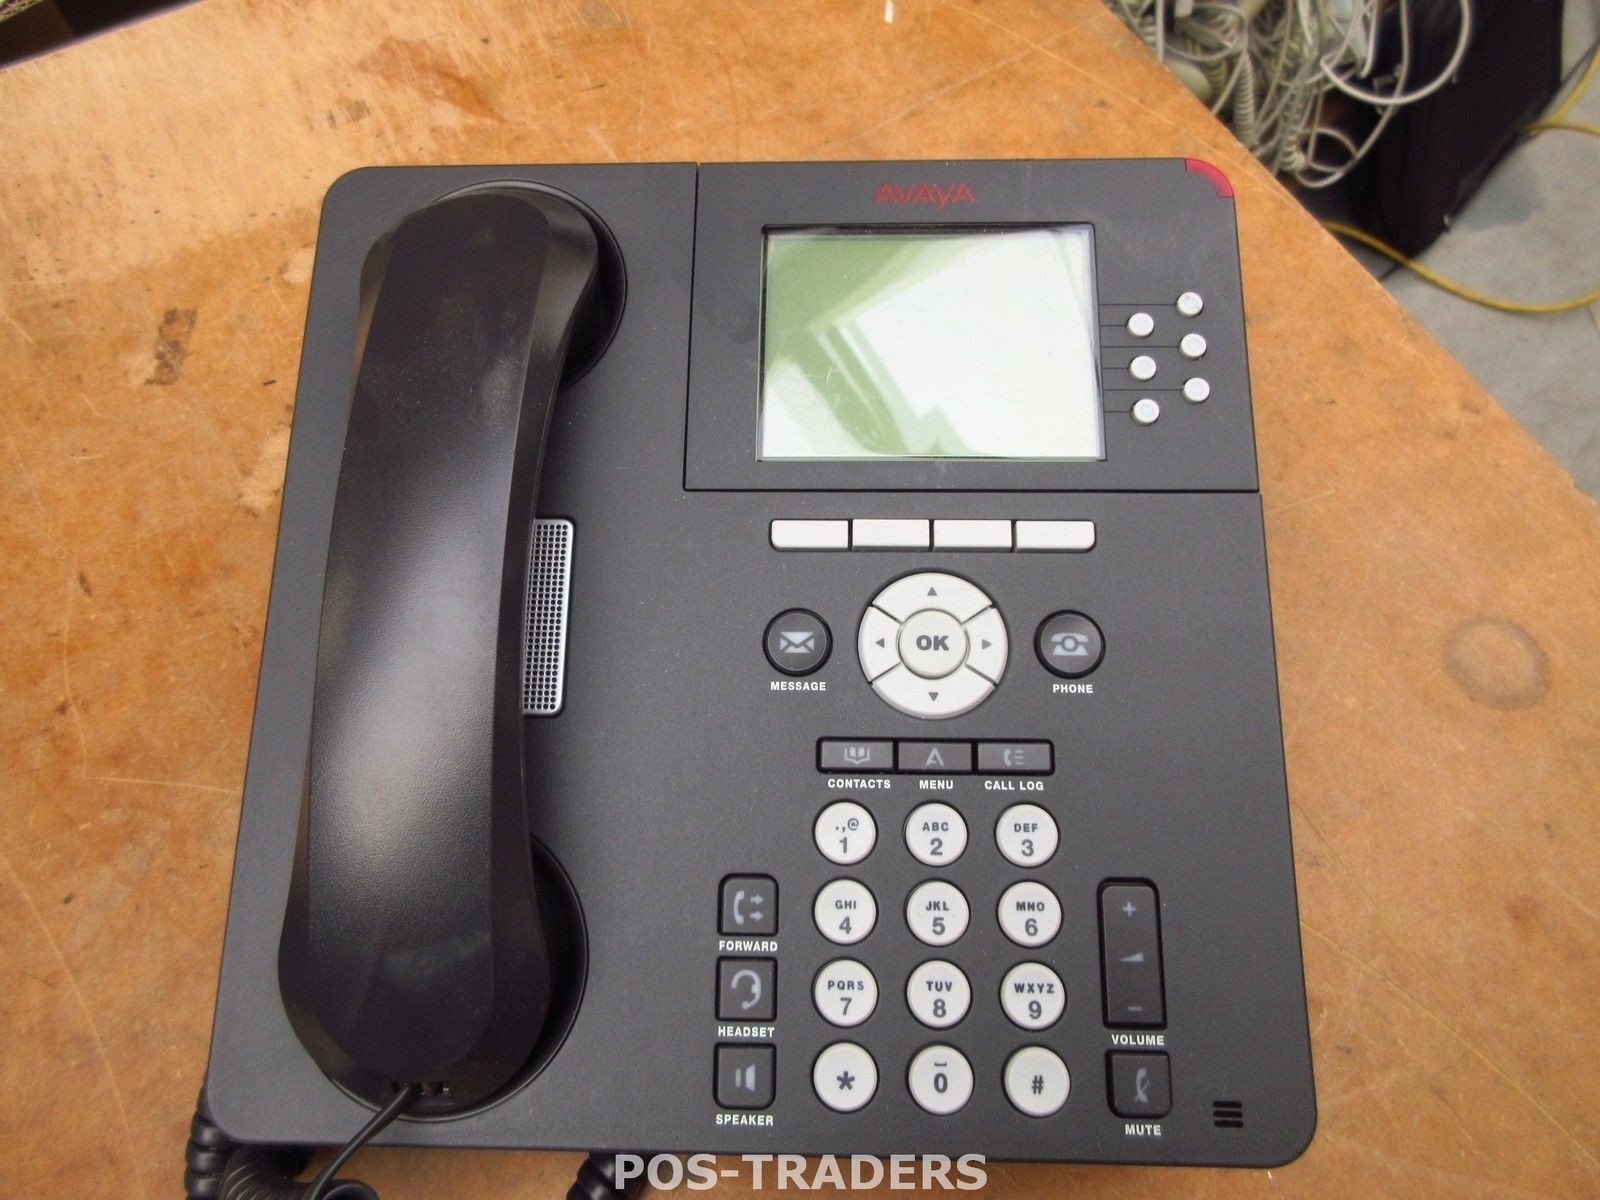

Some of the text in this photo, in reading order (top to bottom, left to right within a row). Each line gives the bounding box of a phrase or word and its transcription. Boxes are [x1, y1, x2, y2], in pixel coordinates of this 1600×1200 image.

[874, 182, 976, 210] AVAYA
[916, 635, 949, 651] OK
[770, 681, 826, 692] MESSAGE
[1052, 684, 1093, 694] PHONE
[827, 778, 891, 789] CONTACTS
[919, 779, 954, 790] MENU
[984, 780, 1044, 791] CALL LOG
[922, 821, 949, 832] ABC
[1013, 823, 1038, 833] DEF
[839, 837, 848, 853] 1
[930, 838, 943, 855] 2
[1021, 839, 1034, 857] 3
[835, 900, 856, 910] GHI
[925, 901, 949, 911] JKL
[1016, 901, 1045, 912] MNO
[839, 917, 851, 934] 4
[932, 917, 945, 935] 5
[1025, 918, 1038, 937] 6
[719, 940, 778, 952] FORWARD
[827, 980, 864, 991] PQRS
[926, 981, 953, 992] TUV
[1014, 983, 1054, 994] WXYZ
[840, 997, 852, 1016] 7
[932, 999, 947, 1018] 8
[1028, 1000, 1042, 1020] 9
[718, 1026, 775, 1038] HEADSET
[1111, 1034, 1165, 1046] VOLUME
[933, 1073, 948, 1094] 0
[716, 1114, 774, 1126] SPEAKER
[1125, 1124, 1162, 1136] MUTE
